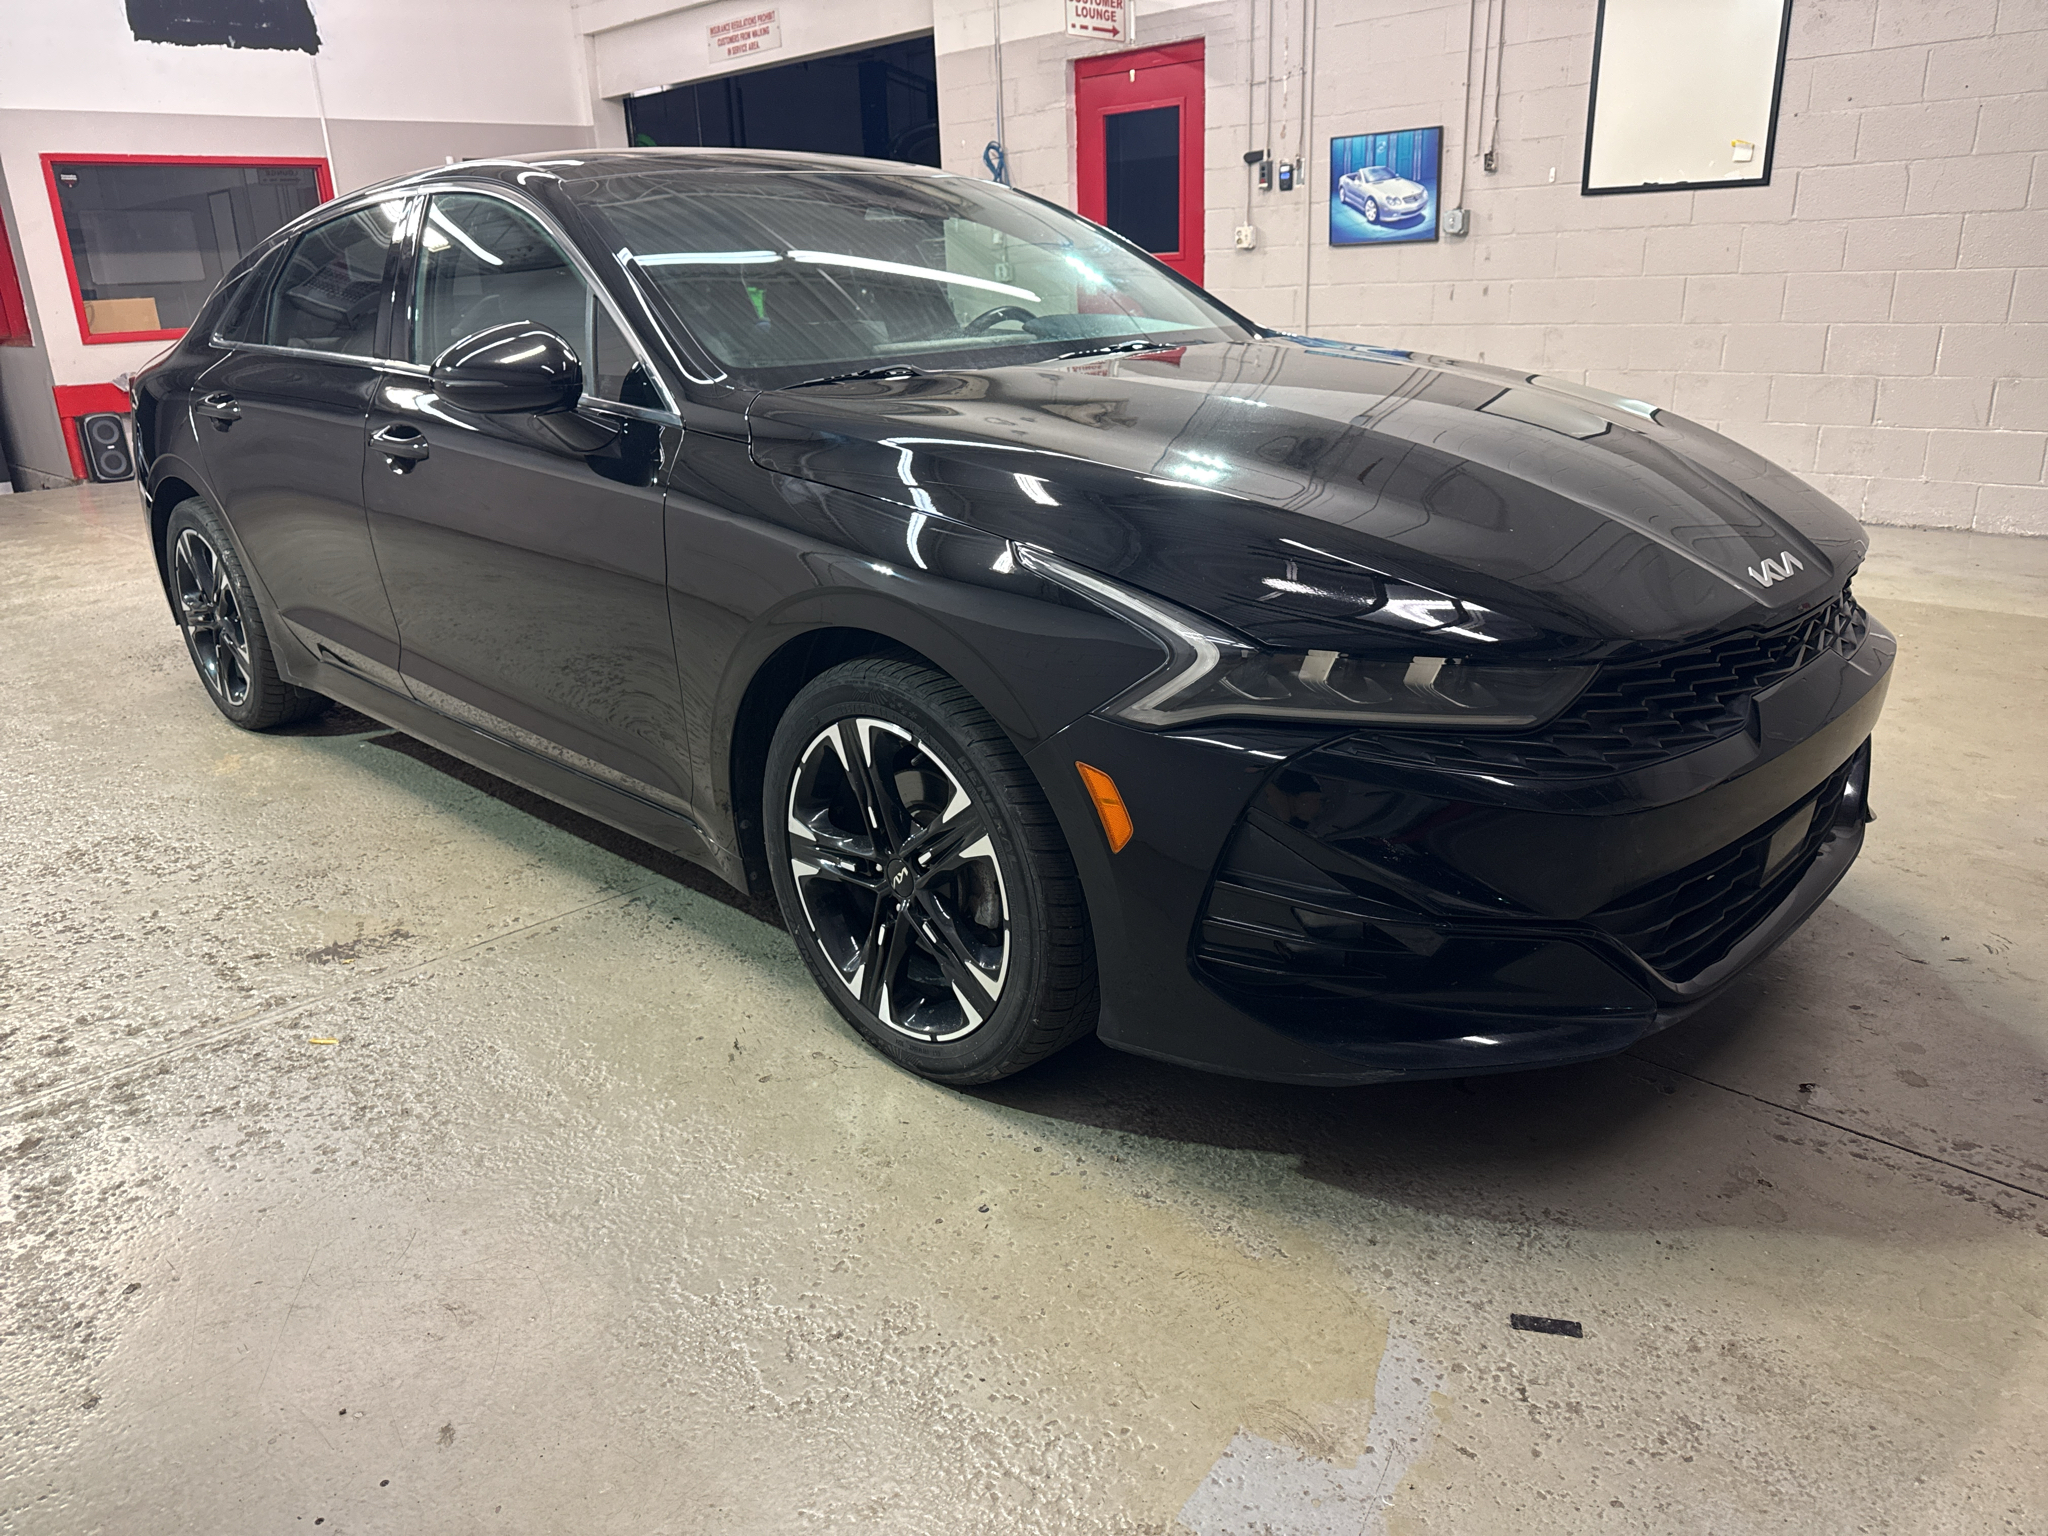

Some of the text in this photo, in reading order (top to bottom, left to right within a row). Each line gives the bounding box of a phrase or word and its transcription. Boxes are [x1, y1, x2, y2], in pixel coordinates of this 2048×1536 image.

[710, 10, 775, 35] INSURANCE REGULATIONS PROHIBIT
[1075, 5, 1117, 22] LOUNGE
[717, 26, 770, 47] CUSTOMERS FROM WALKING
[732, 43, 748, 55] SERVICE
[748, 40, 760, 51] AREA
[1748, 551, 1804, 588] KIA
[957, 756, 1017, 870] GENERAL
